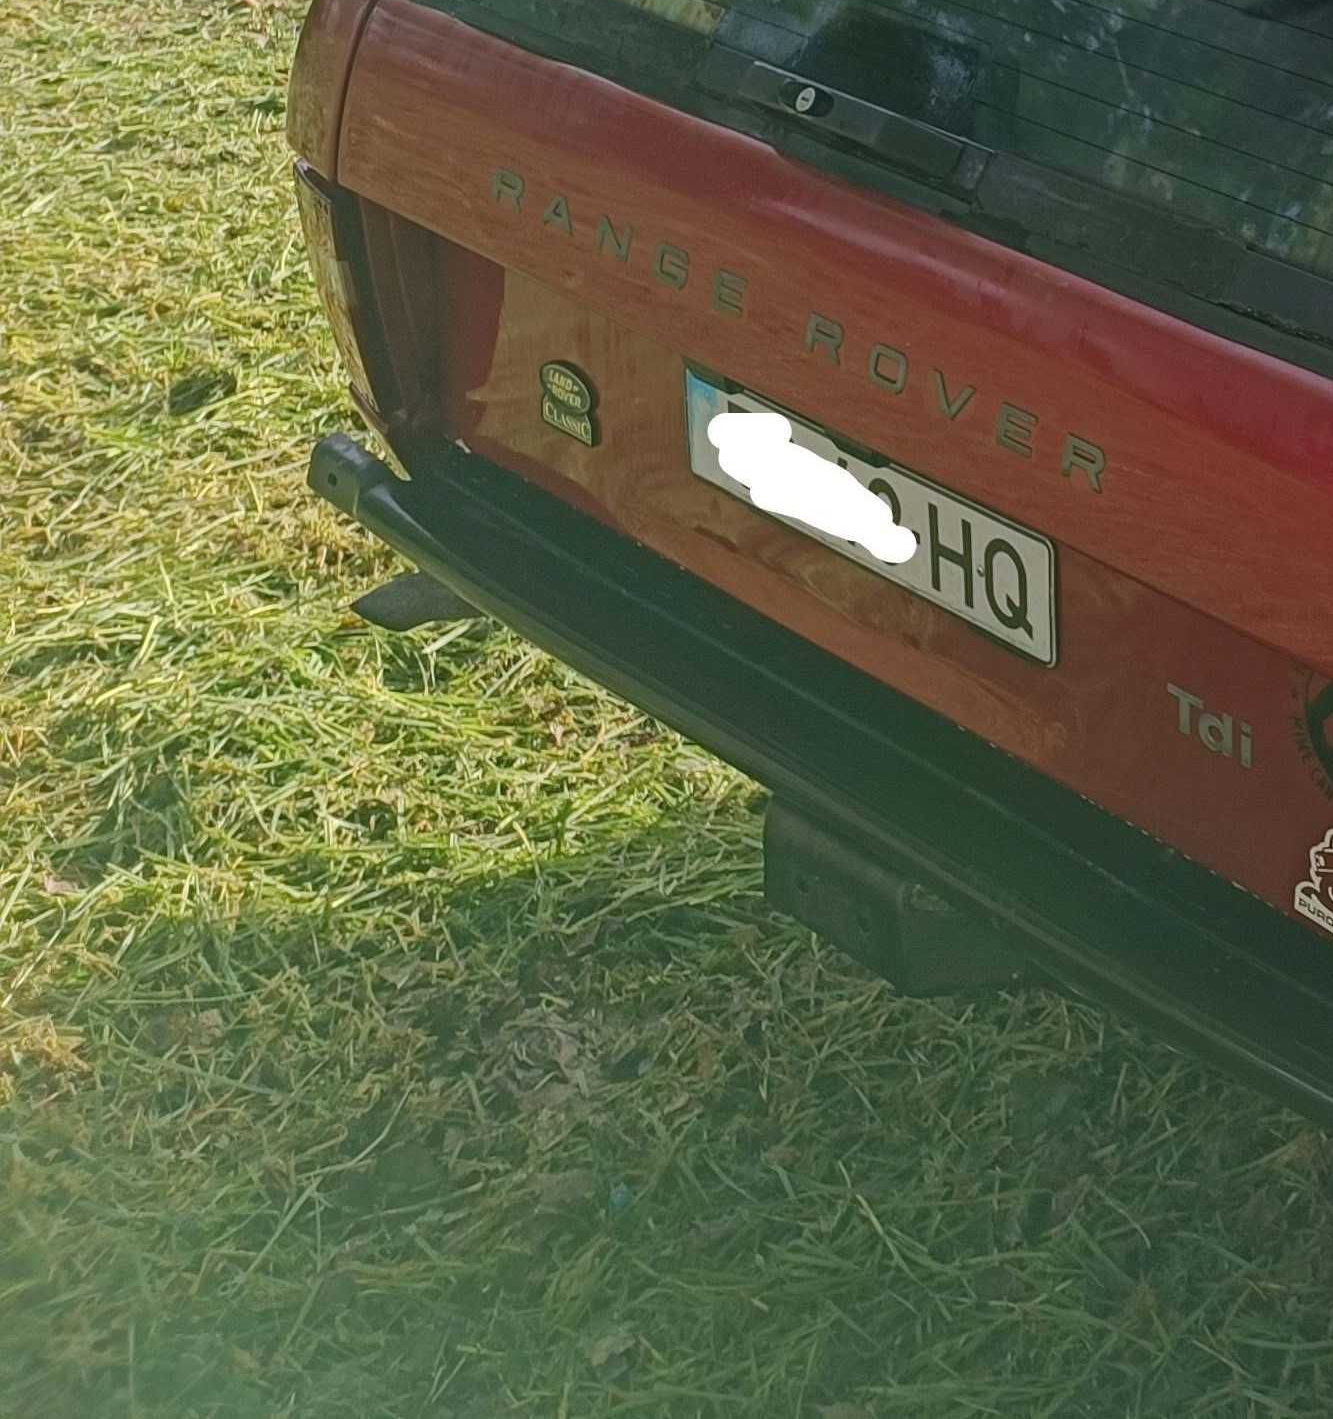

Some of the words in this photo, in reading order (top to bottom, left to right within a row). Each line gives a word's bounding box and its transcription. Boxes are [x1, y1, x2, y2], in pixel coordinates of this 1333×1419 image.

[490, 169, 748, 318] RANGE
[545, 401, 591, 441] CLASSIC
[551, 385, 582, 409] ROVER
[805, 311, 1108, 494] ROVER
[1166, 681, 1253, 770] Tdi
